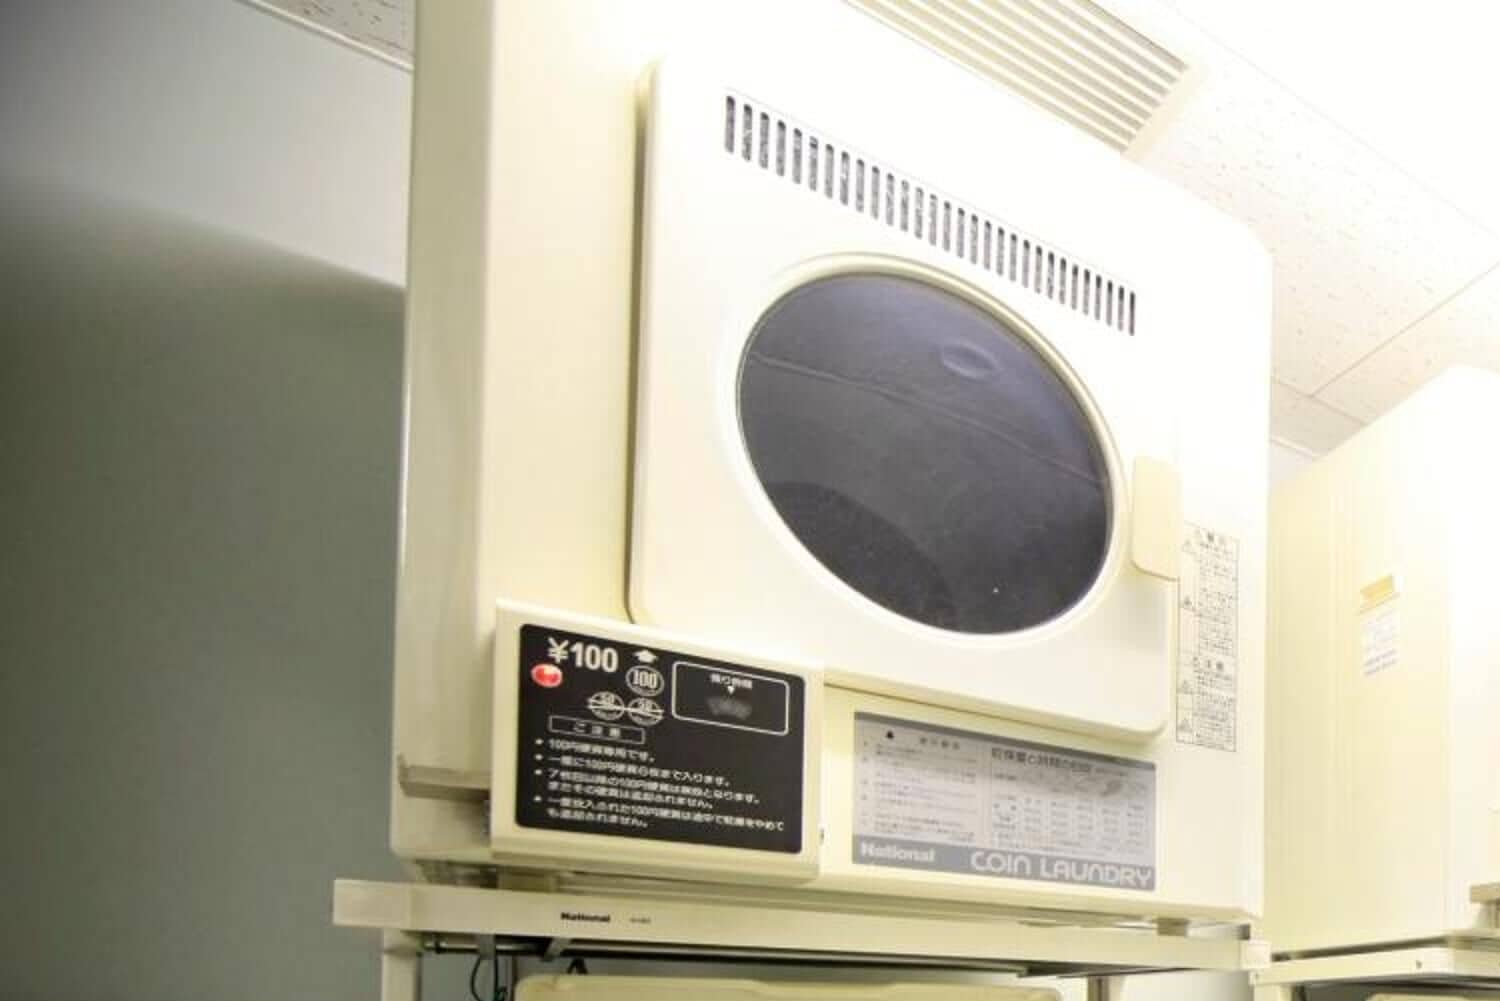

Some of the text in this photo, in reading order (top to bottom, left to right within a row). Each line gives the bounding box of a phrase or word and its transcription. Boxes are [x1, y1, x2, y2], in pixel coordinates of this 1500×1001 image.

[547, 637, 619, 673] ¥100
[632, 669, 658, 689] 100
[860, 841, 935, 862] National
[970, 850, 1152, 887] COIN LAUNDRY
